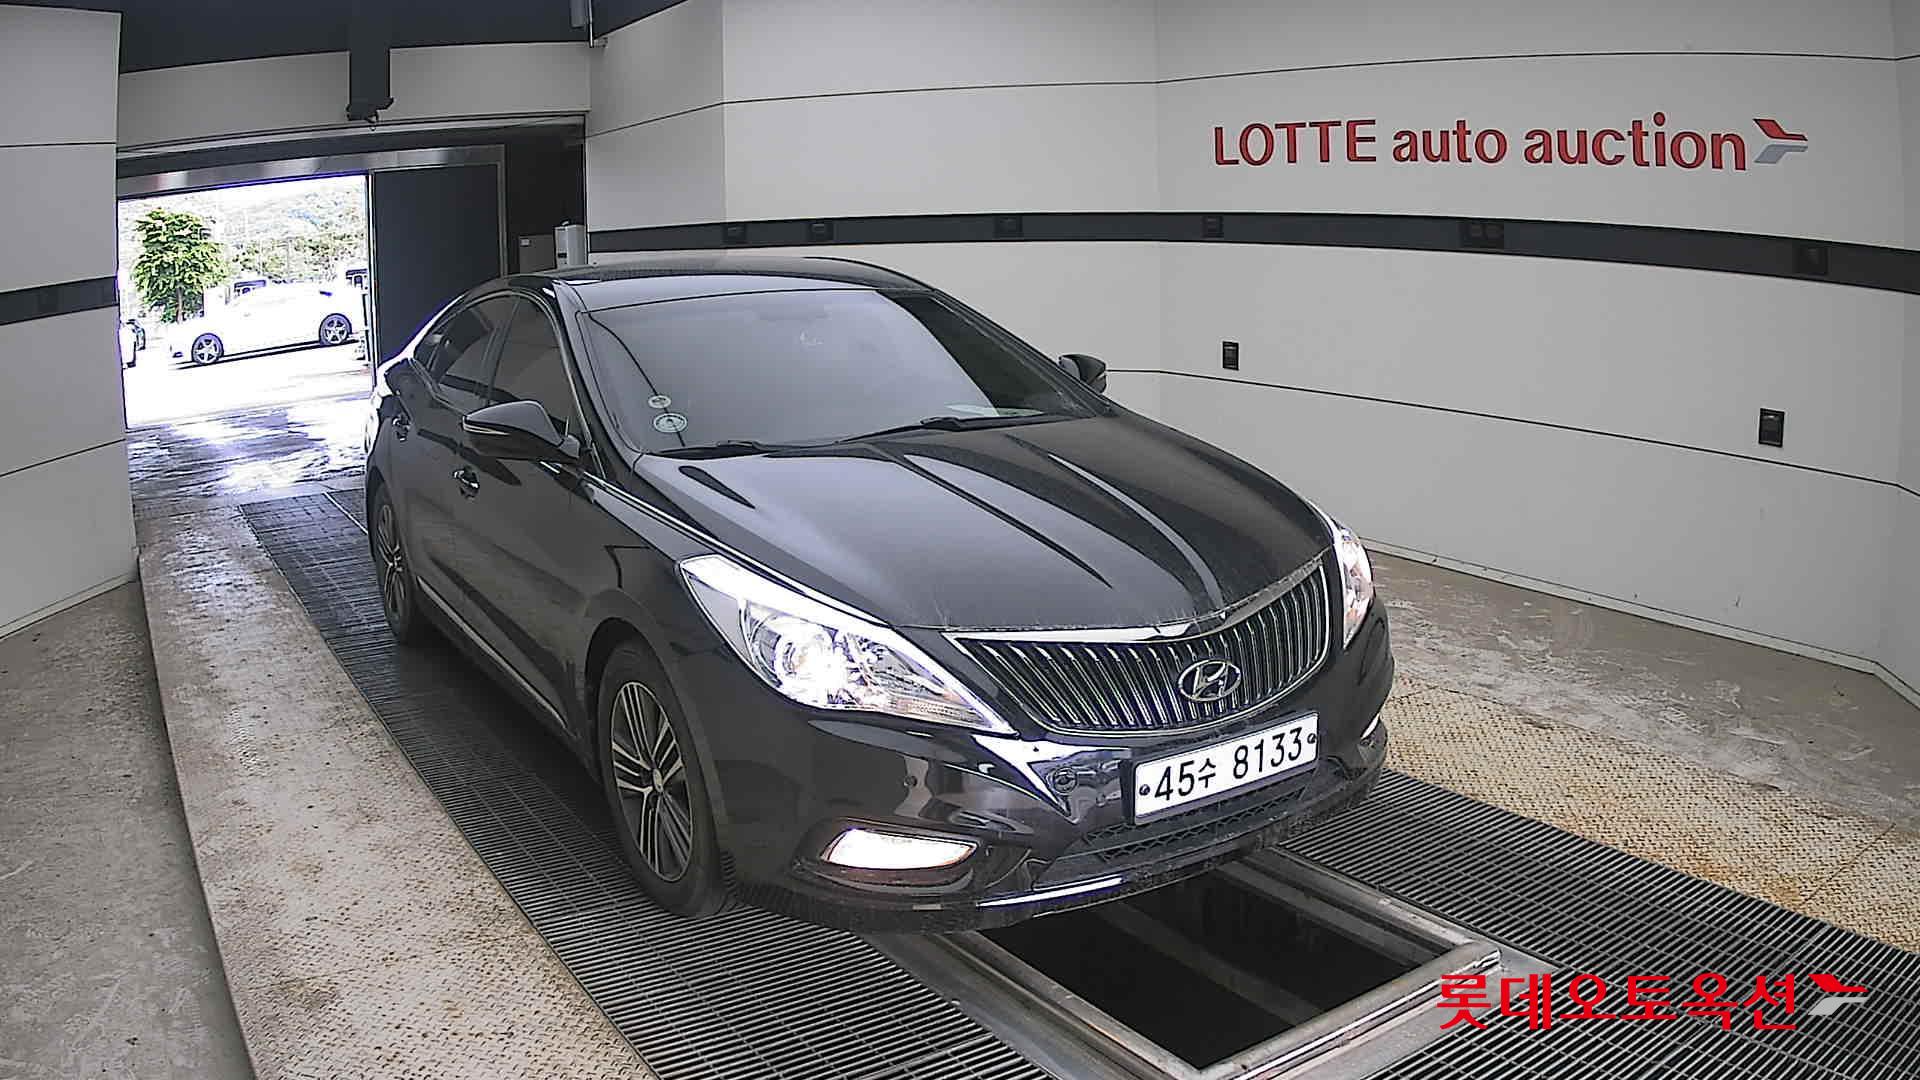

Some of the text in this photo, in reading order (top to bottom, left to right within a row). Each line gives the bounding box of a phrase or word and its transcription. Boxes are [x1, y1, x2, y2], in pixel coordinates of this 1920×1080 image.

[1214, 111, 1747, 171] LOTTE auto auction
[1154, 726, 1303, 802] 45수 8133
